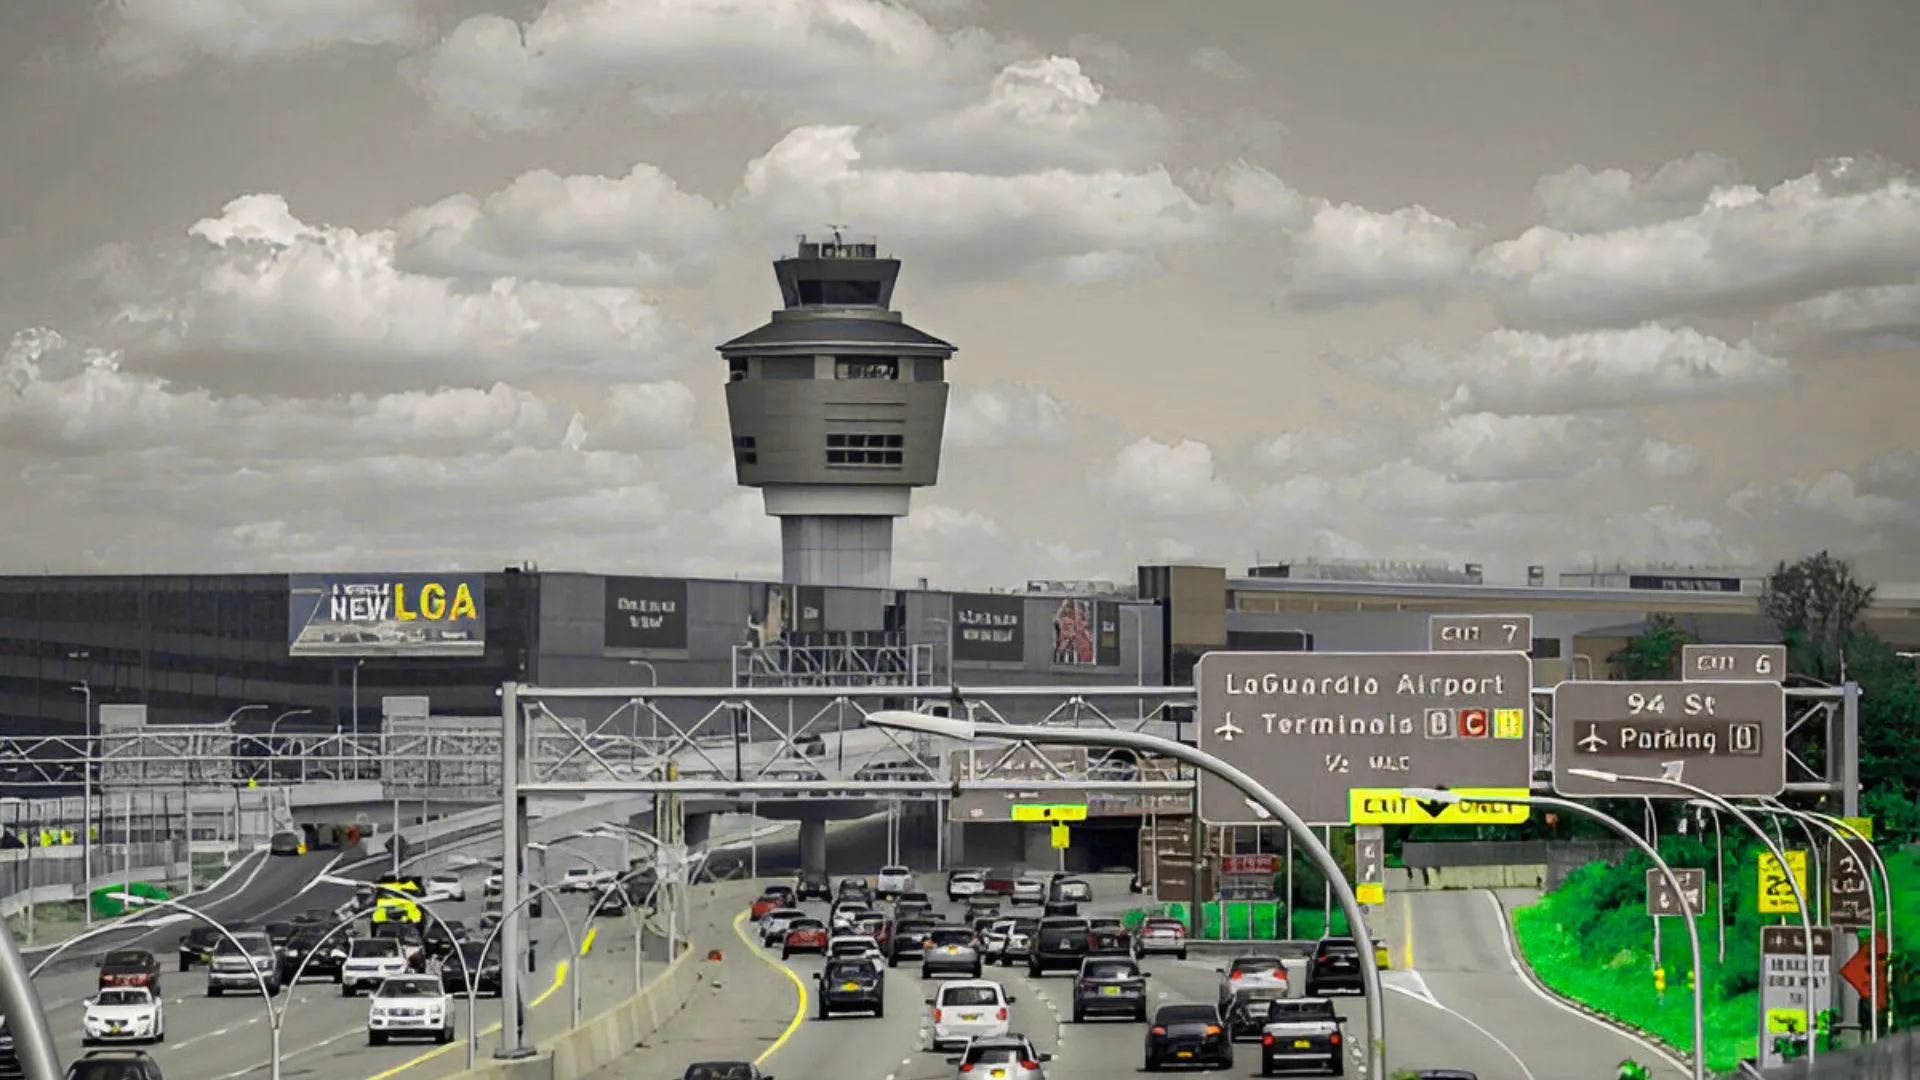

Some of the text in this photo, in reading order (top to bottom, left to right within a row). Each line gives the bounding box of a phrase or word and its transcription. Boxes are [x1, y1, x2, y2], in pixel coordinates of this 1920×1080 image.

[331, 582, 477, 621] NEW LGA
[1501, 624, 1518, 643] 7
[1756, 654, 1771, 674] 6
[1226, 673, 1504, 697] LaGuardia Airport
[1627, 693, 1716, 715] 94 St
[1261, 712, 1413, 735] Terminals
[1466, 711, 1484, 735] C
[1620, 726, 1717, 754] Parking
